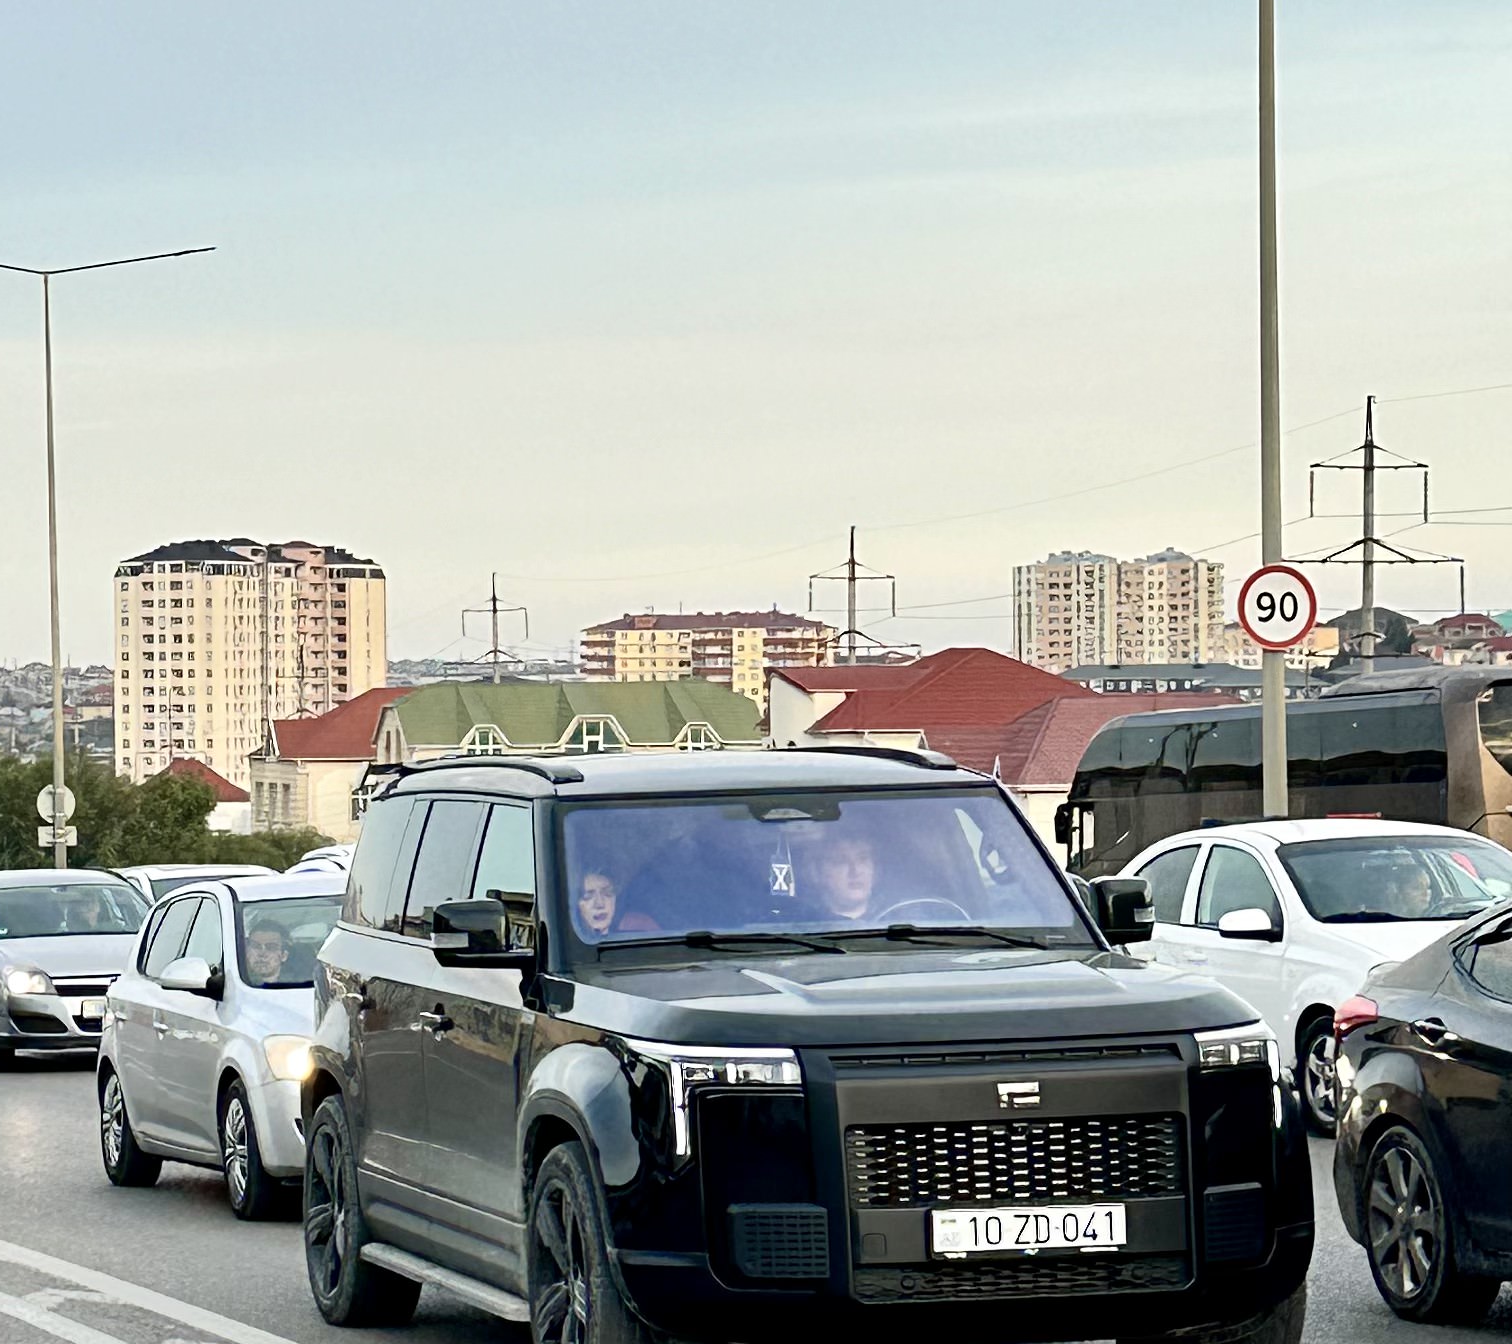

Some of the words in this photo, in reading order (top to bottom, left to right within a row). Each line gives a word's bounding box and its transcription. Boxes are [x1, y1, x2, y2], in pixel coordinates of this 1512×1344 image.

[1256, 591, 1298, 623] 90
[969, 1216, 1002, 1247] 10
[1013, 1214, 1051, 1245] ZD
[1062, 1211, 1114, 1243] 041
